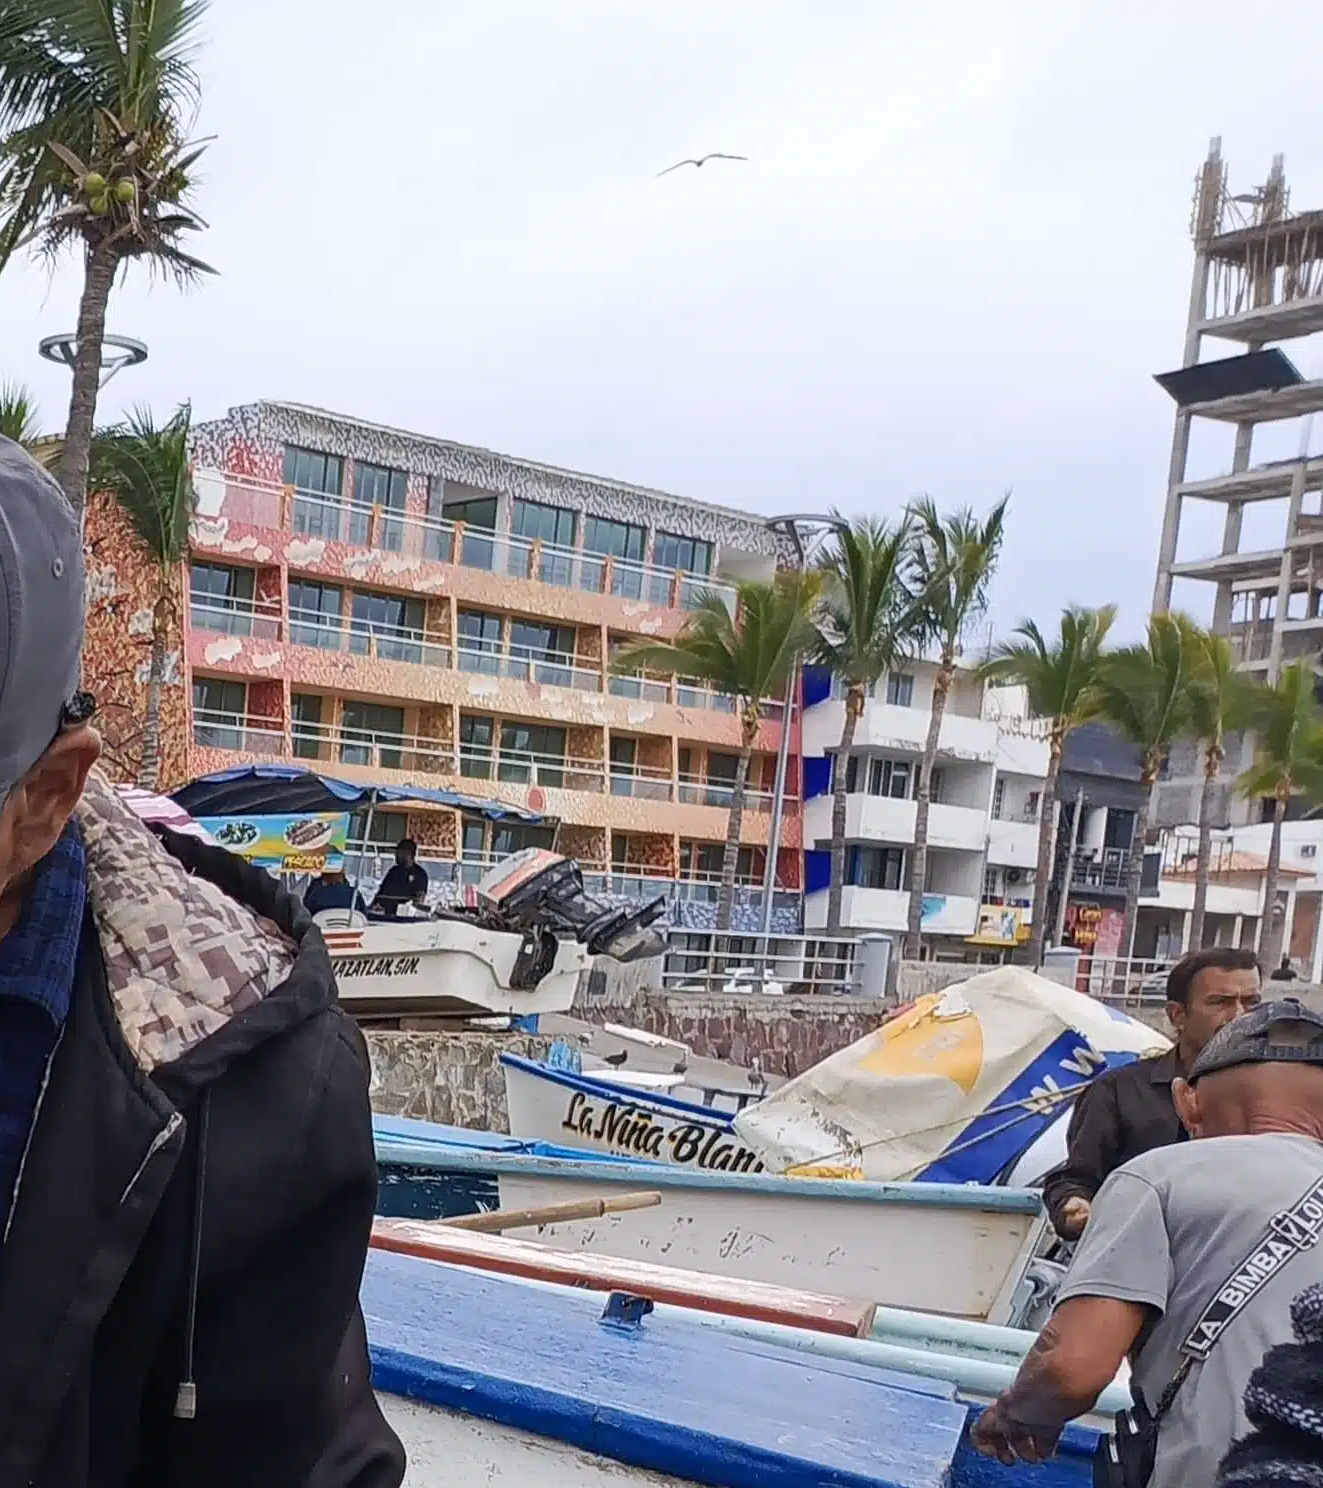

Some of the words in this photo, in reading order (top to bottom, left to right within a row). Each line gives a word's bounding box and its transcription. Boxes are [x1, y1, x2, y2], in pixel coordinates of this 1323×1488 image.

[562, 1091, 593, 1138] La
[593, 1104, 666, 1157] Niña
[666, 1124, 764, 1173] Blan
[1186, 1320, 1223, 1349] LA
[1218, 1239, 1294, 1308] BIMBA
